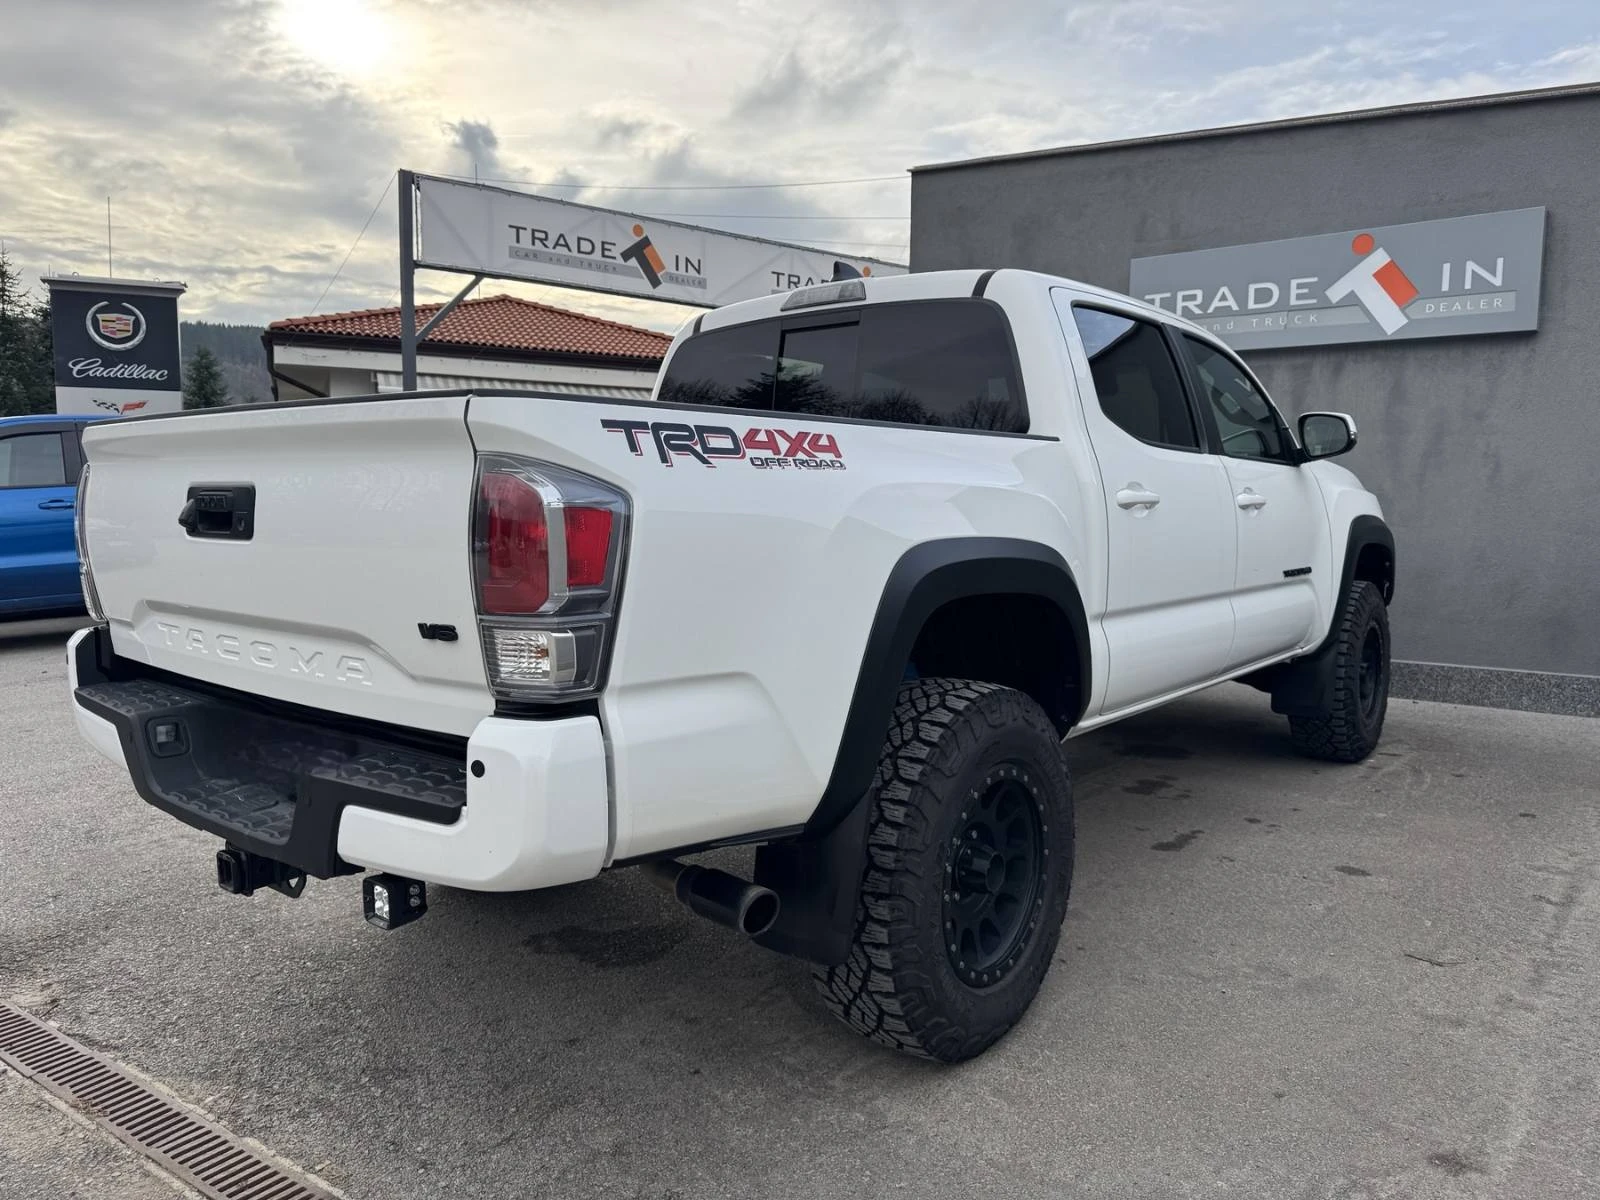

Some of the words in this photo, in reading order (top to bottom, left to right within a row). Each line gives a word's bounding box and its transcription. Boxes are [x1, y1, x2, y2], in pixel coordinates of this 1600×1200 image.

[508, 224, 617, 260] TRADE
[675, 254, 702, 275] IN
[514, 249, 539, 260] CAR
[771, 271, 831, 289] TRA
[1144, 276, 1319, 318] TRADE
[1441, 257, 1504, 292] IN
[1252, 314, 1318, 329] TRUCK
[1425, 298, 1502, 313] DEALER
[68, 358, 168, 381] Cadillac
[600, 419, 746, 468] TRD
[749, 456, 791, 470] OFF
[792, 458, 847, 471] ROAD
[417, 622, 459, 641] V6
[157, 621, 374, 687] TACOMA
